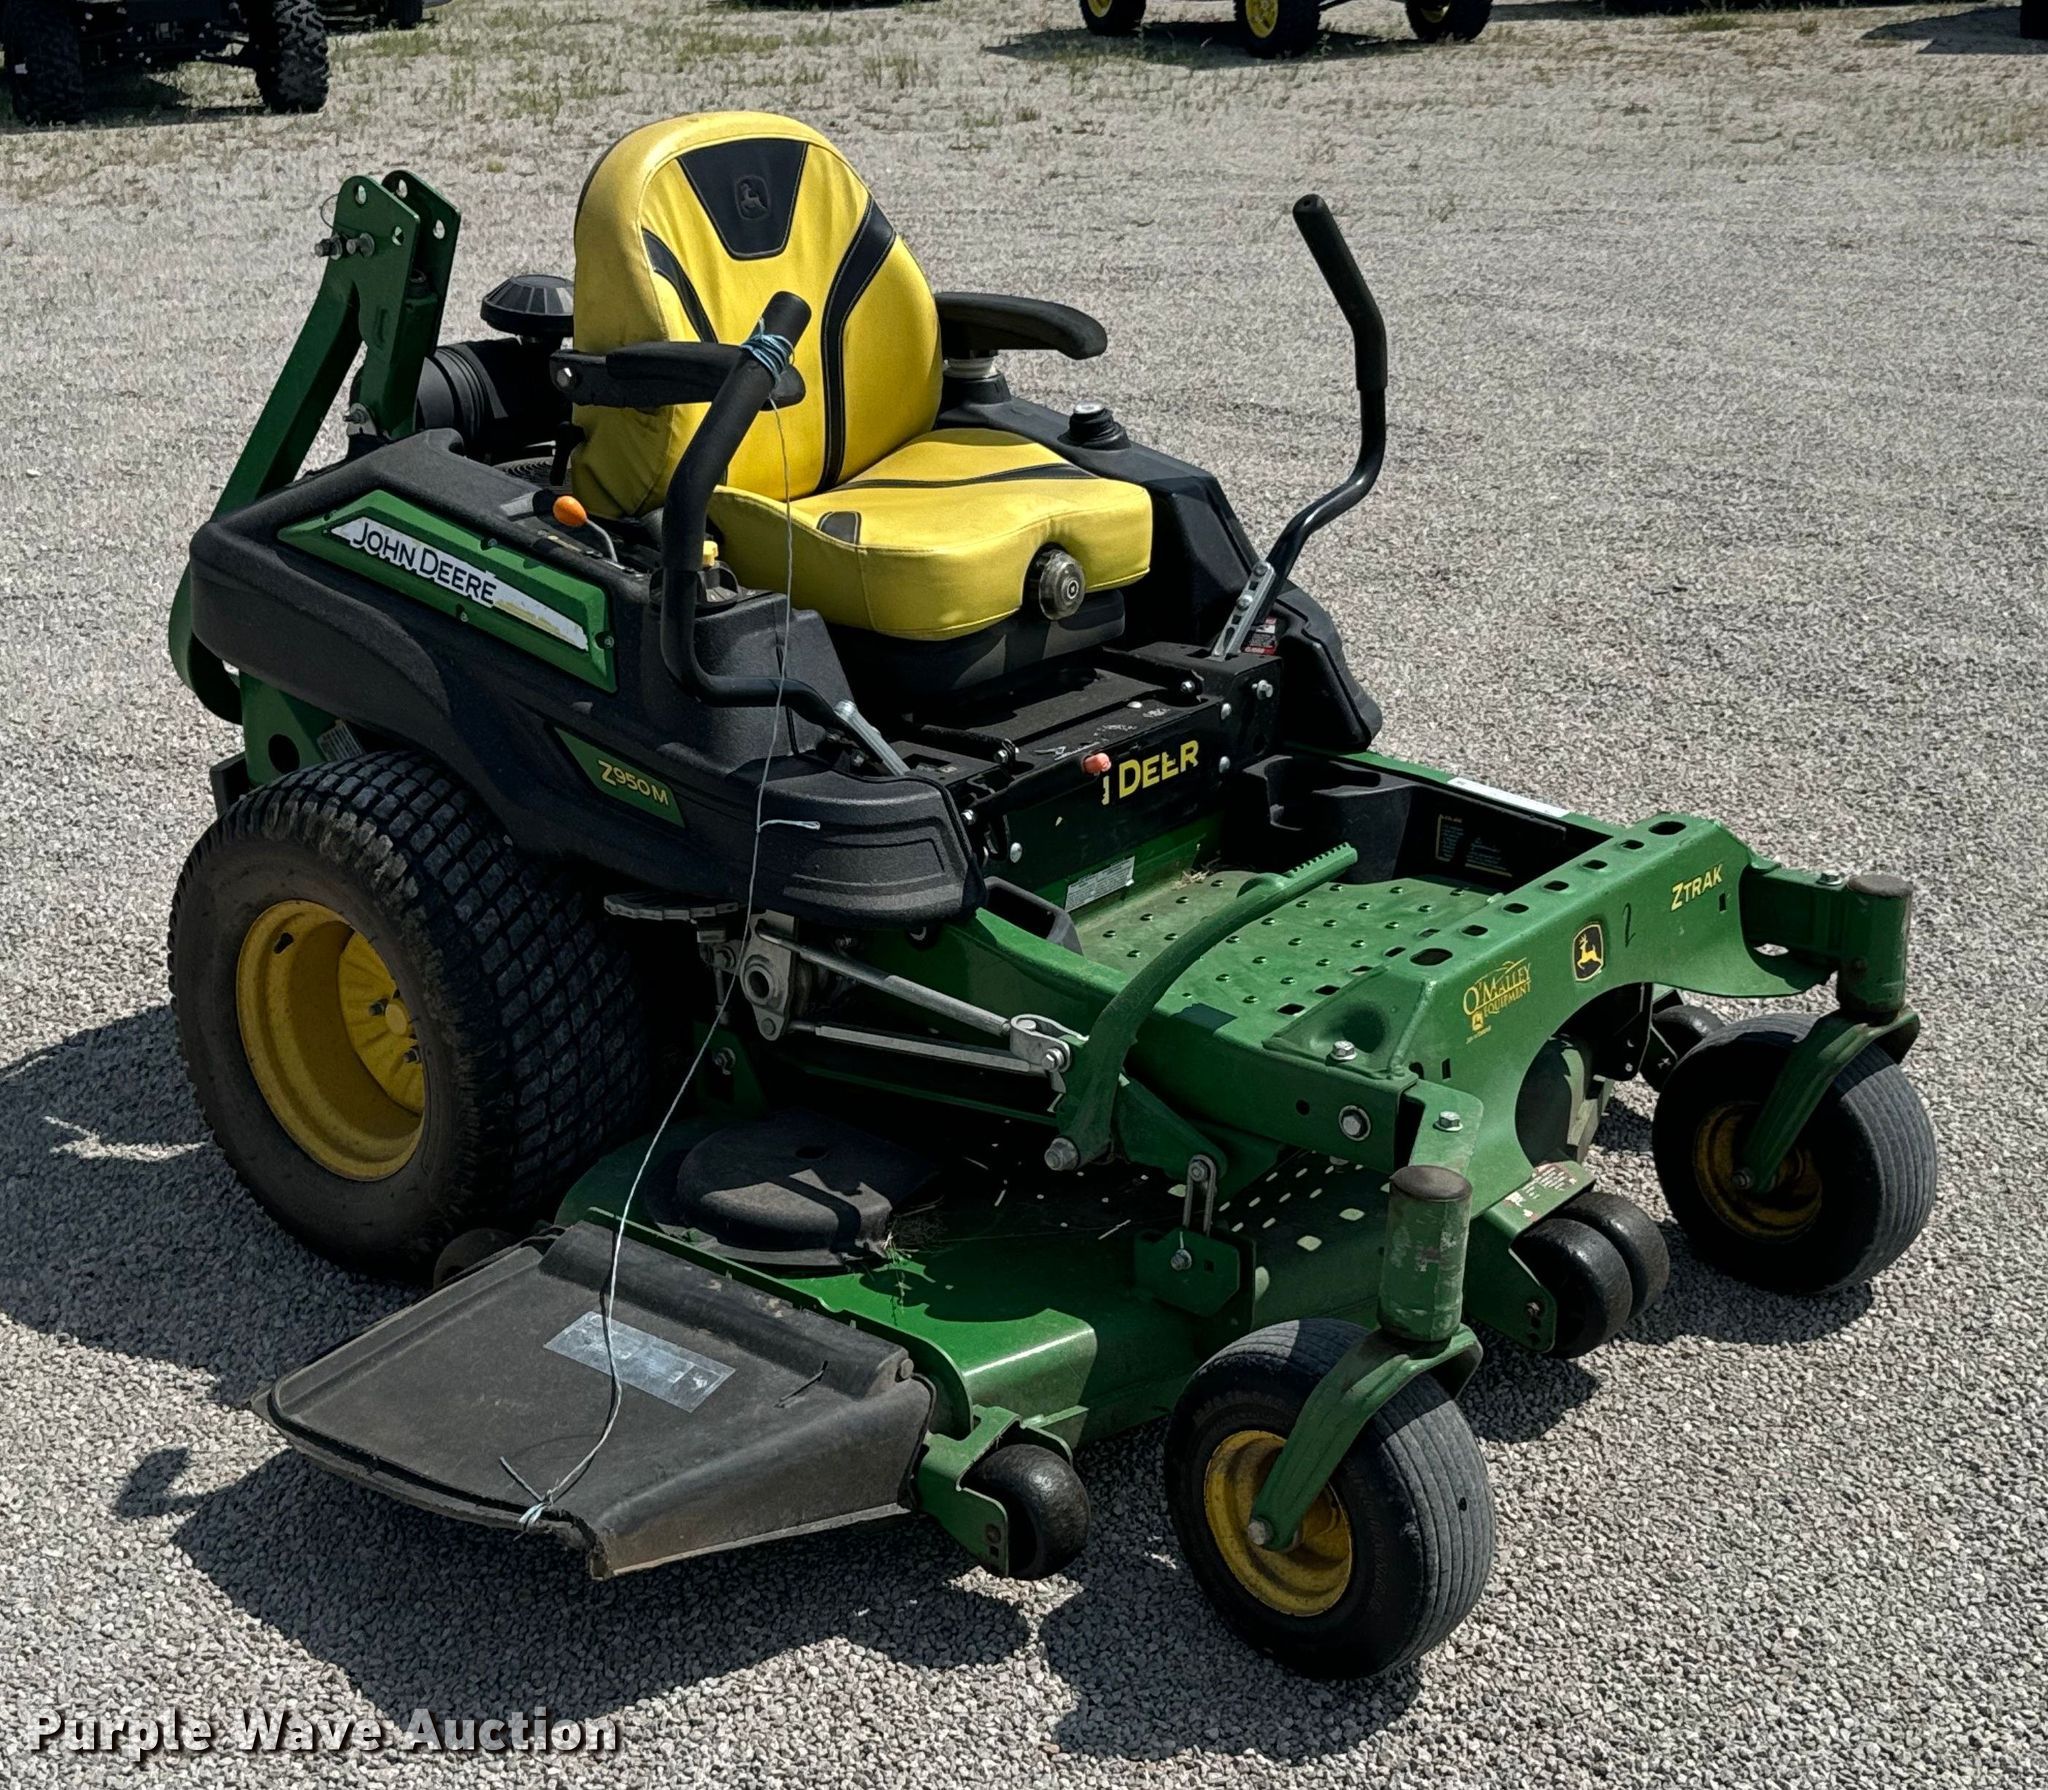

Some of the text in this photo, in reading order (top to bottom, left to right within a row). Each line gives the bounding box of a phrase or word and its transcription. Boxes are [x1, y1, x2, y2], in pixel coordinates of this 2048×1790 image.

[350, 520, 498, 603] JOHN DEERE
[597, 760, 670, 806] Z950M
[1670, 863, 1723, 912] ZTRAK
[1463, 963, 1531, 1015] O'MALLEY
